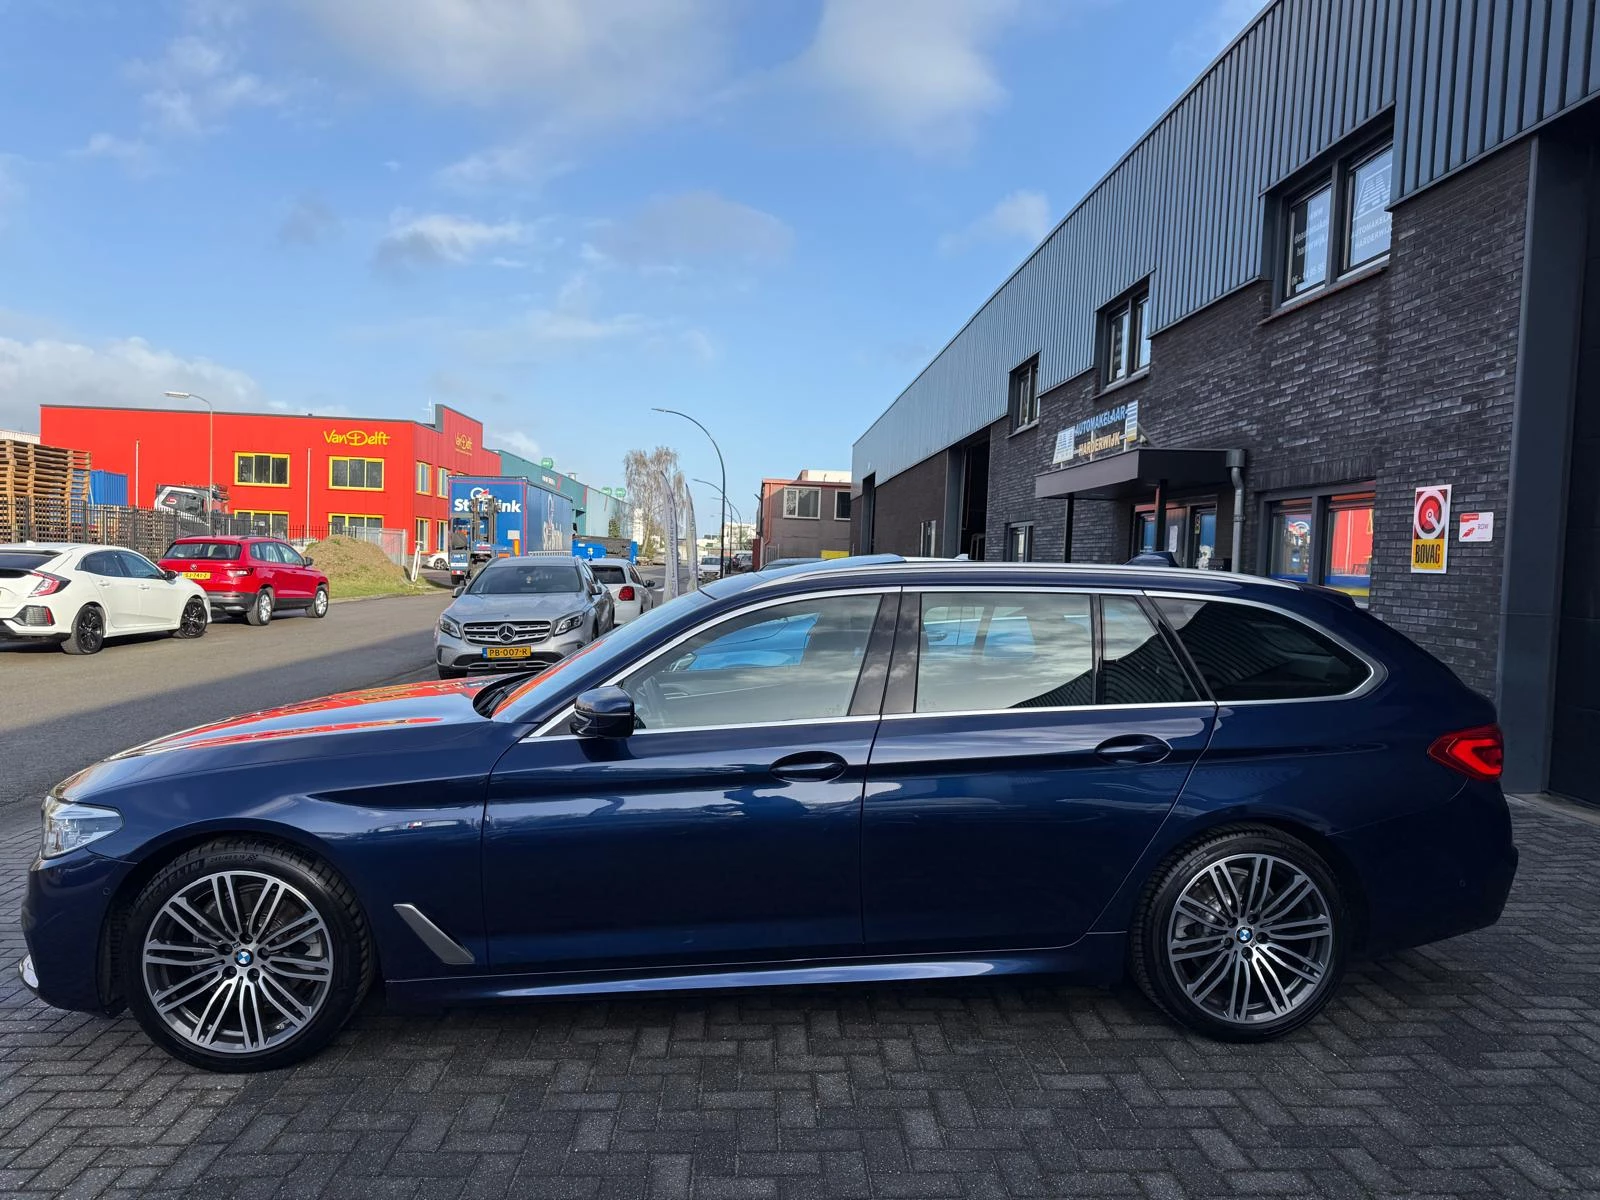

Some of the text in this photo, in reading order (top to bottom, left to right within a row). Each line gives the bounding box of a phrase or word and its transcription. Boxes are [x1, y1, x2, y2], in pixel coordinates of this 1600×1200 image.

[1074, 405, 1126, 436] AUTOMAKELAAR
[1079, 431, 1120, 457] HARDERWIJK
[1415, 544, 1441, 563] BOVAG
